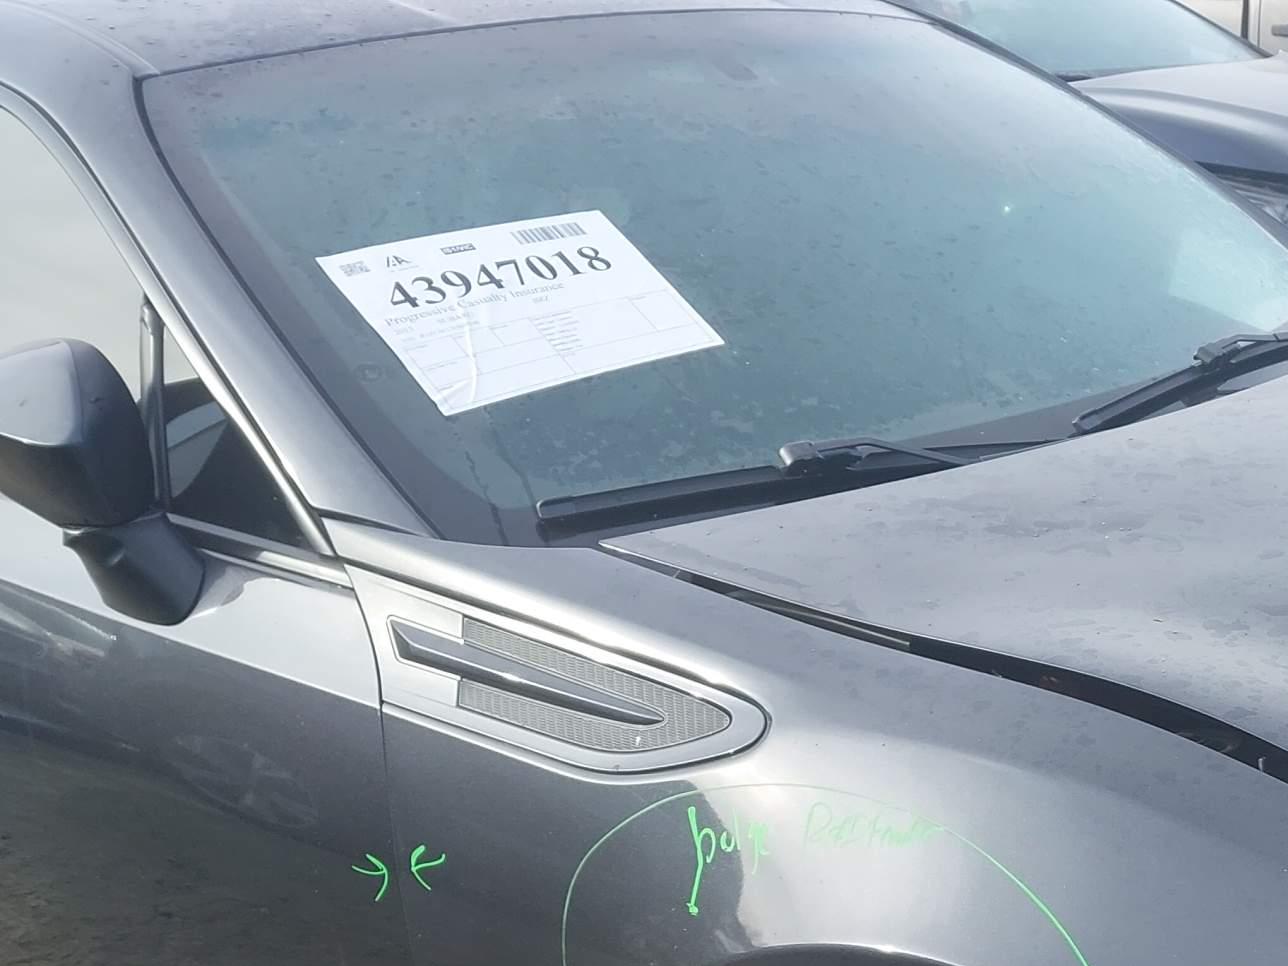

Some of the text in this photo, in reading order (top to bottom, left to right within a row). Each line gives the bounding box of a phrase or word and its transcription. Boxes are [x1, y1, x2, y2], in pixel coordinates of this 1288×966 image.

[390, 246, 612, 308] 43947018
[384, 303, 456, 327] Progressive
[457, 291, 508, 309] Casualty
[510, 282, 565, 298] Insurance
